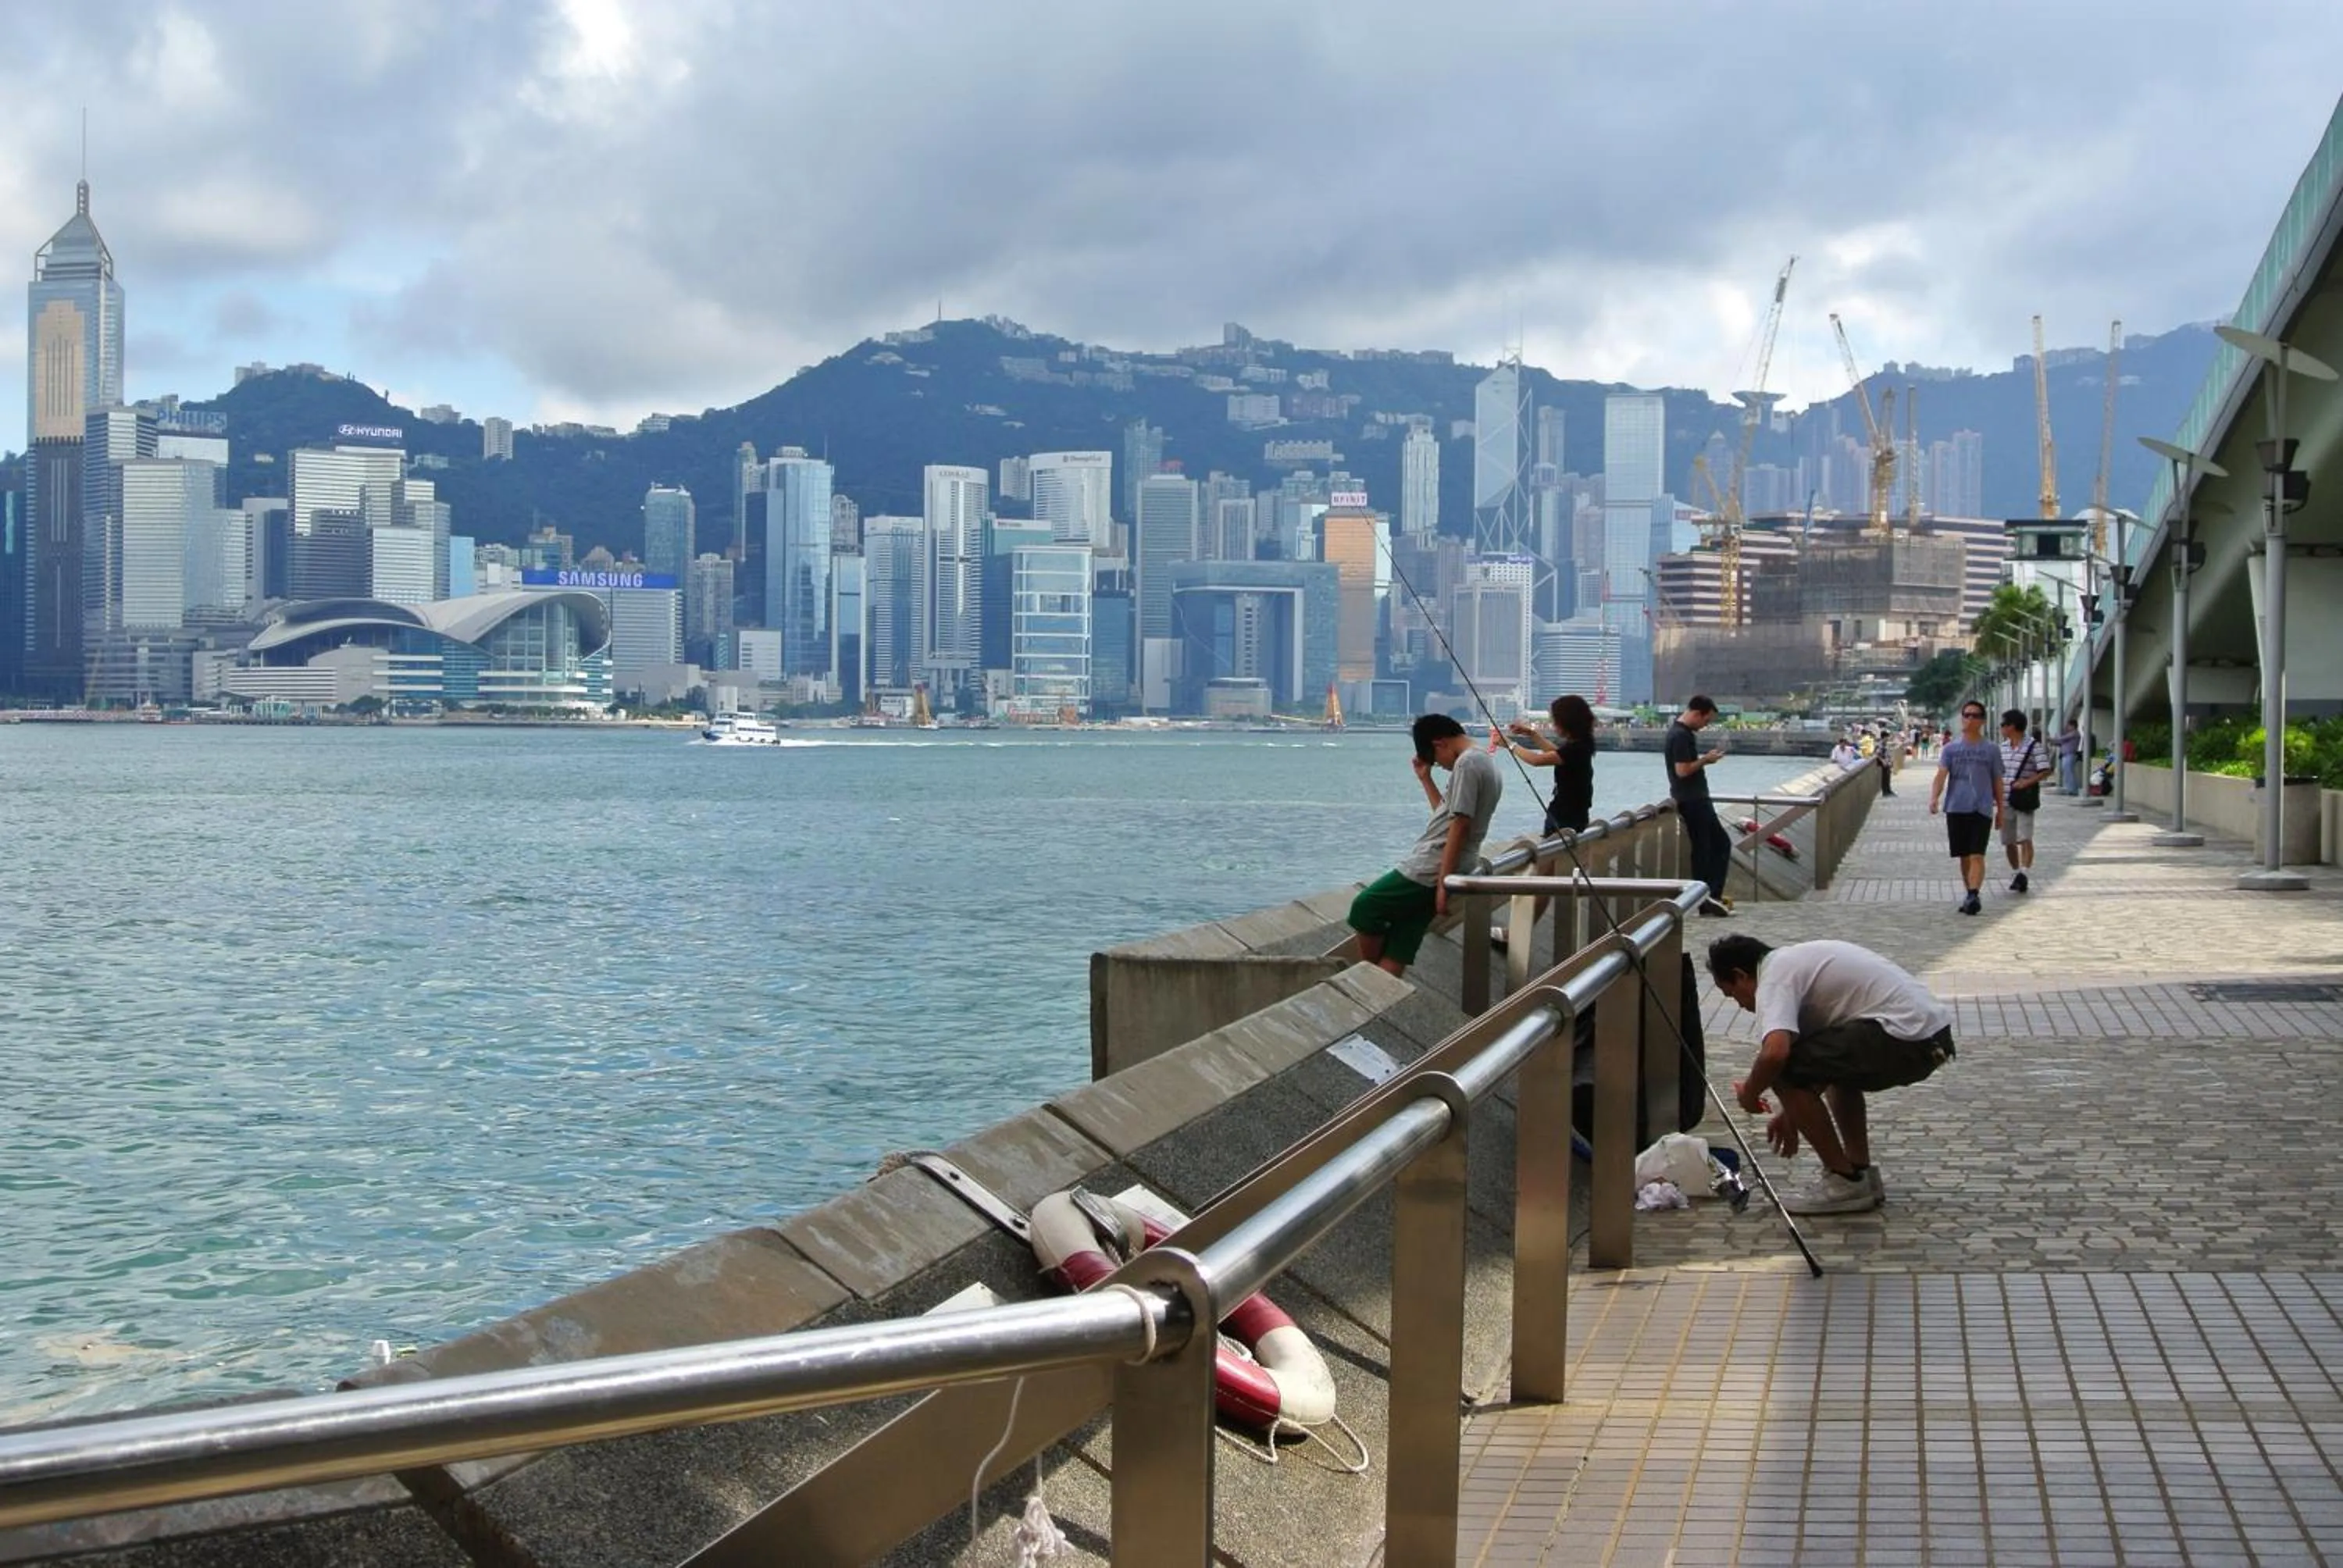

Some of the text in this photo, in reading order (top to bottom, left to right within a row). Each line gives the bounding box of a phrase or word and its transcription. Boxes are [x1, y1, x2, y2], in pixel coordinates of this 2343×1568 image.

[158, 409, 225, 426] PHILIPS
[357, 426, 402, 437] HYUNDAI
[558, 571, 643, 587] SAMSUNG
